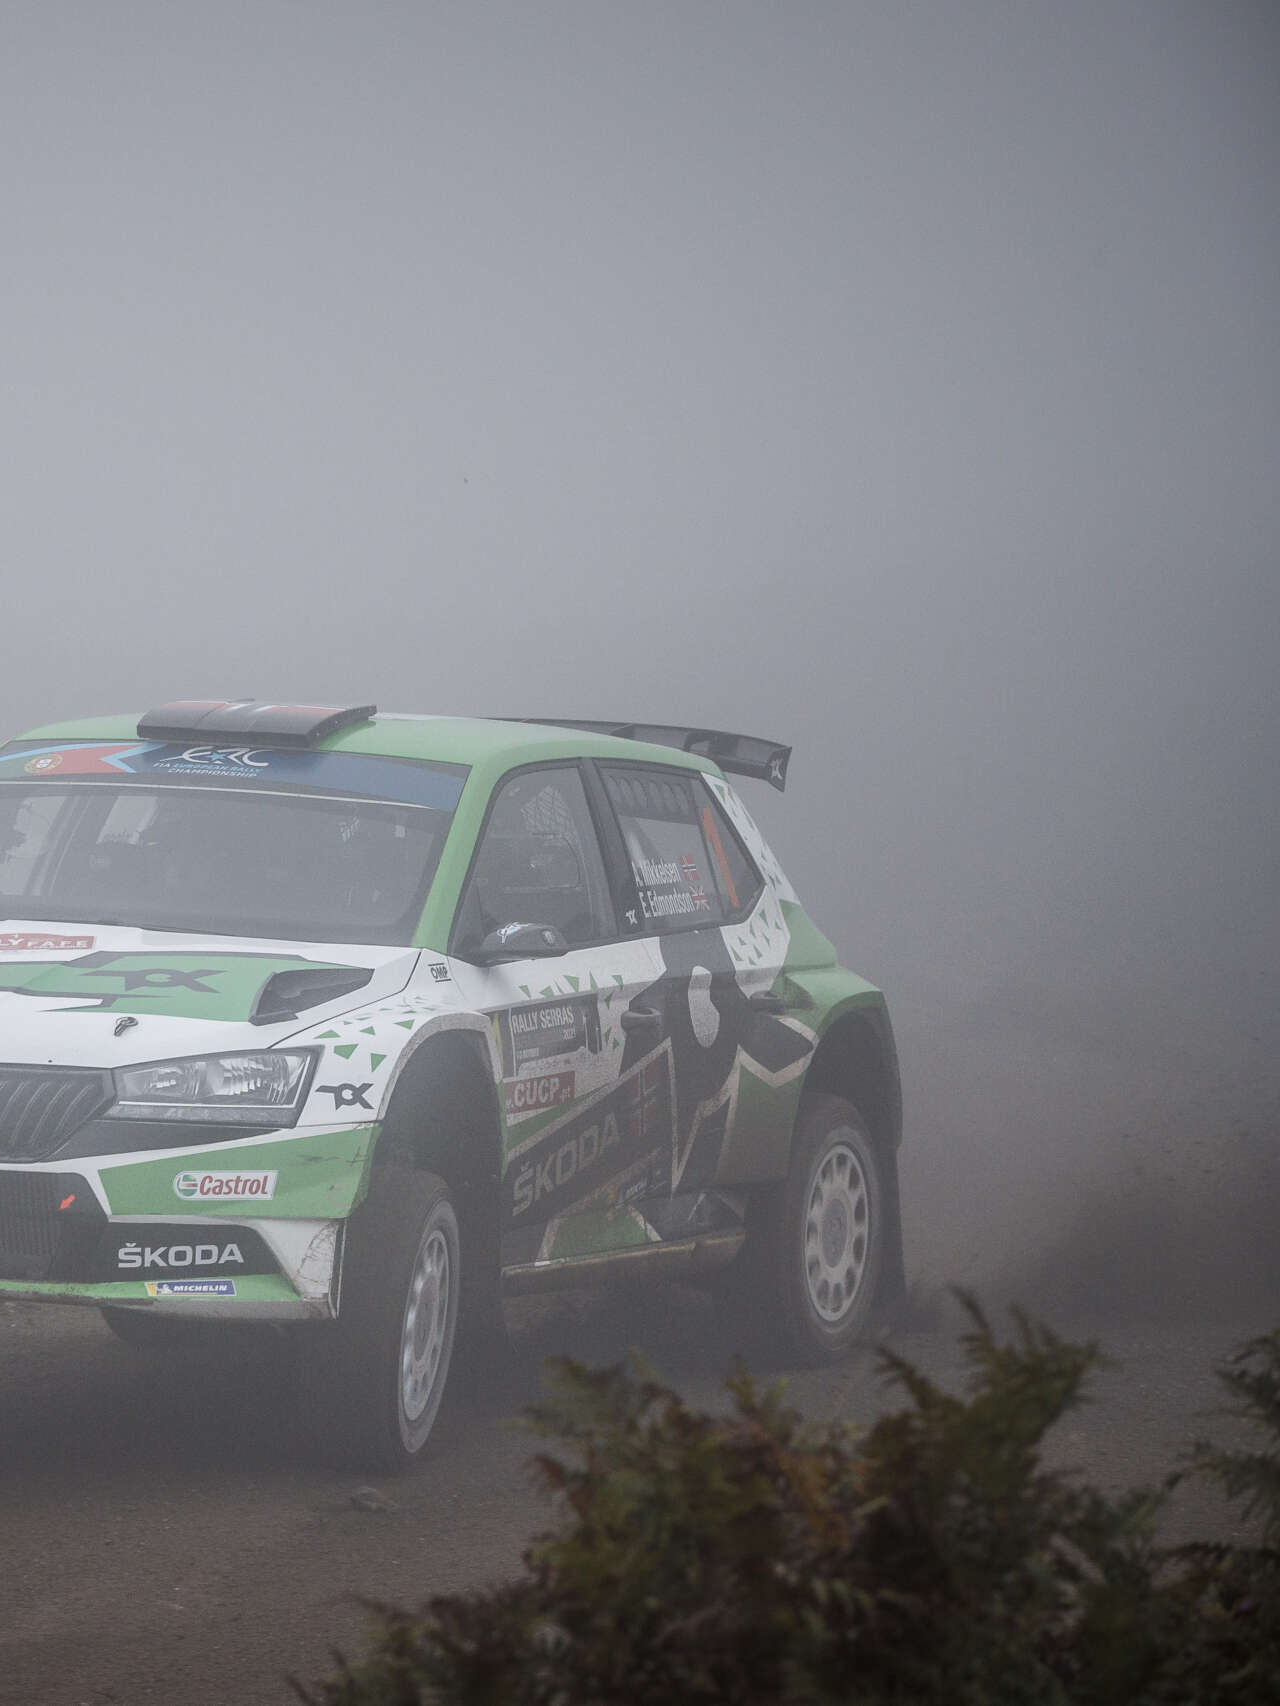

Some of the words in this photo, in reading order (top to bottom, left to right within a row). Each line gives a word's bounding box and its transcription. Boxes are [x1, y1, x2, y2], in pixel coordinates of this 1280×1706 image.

[167, 767, 258, 778] CHAMPIONSHIP
[511, 1012, 539, 1034] RALLY
[539, 1007, 575, 1029] SERRAS
[199, 1174, 269, 1196] Castrol
[117, 1243, 245, 1269] ŠKODA
[173, 1284, 228, 1292] MICHELIN
